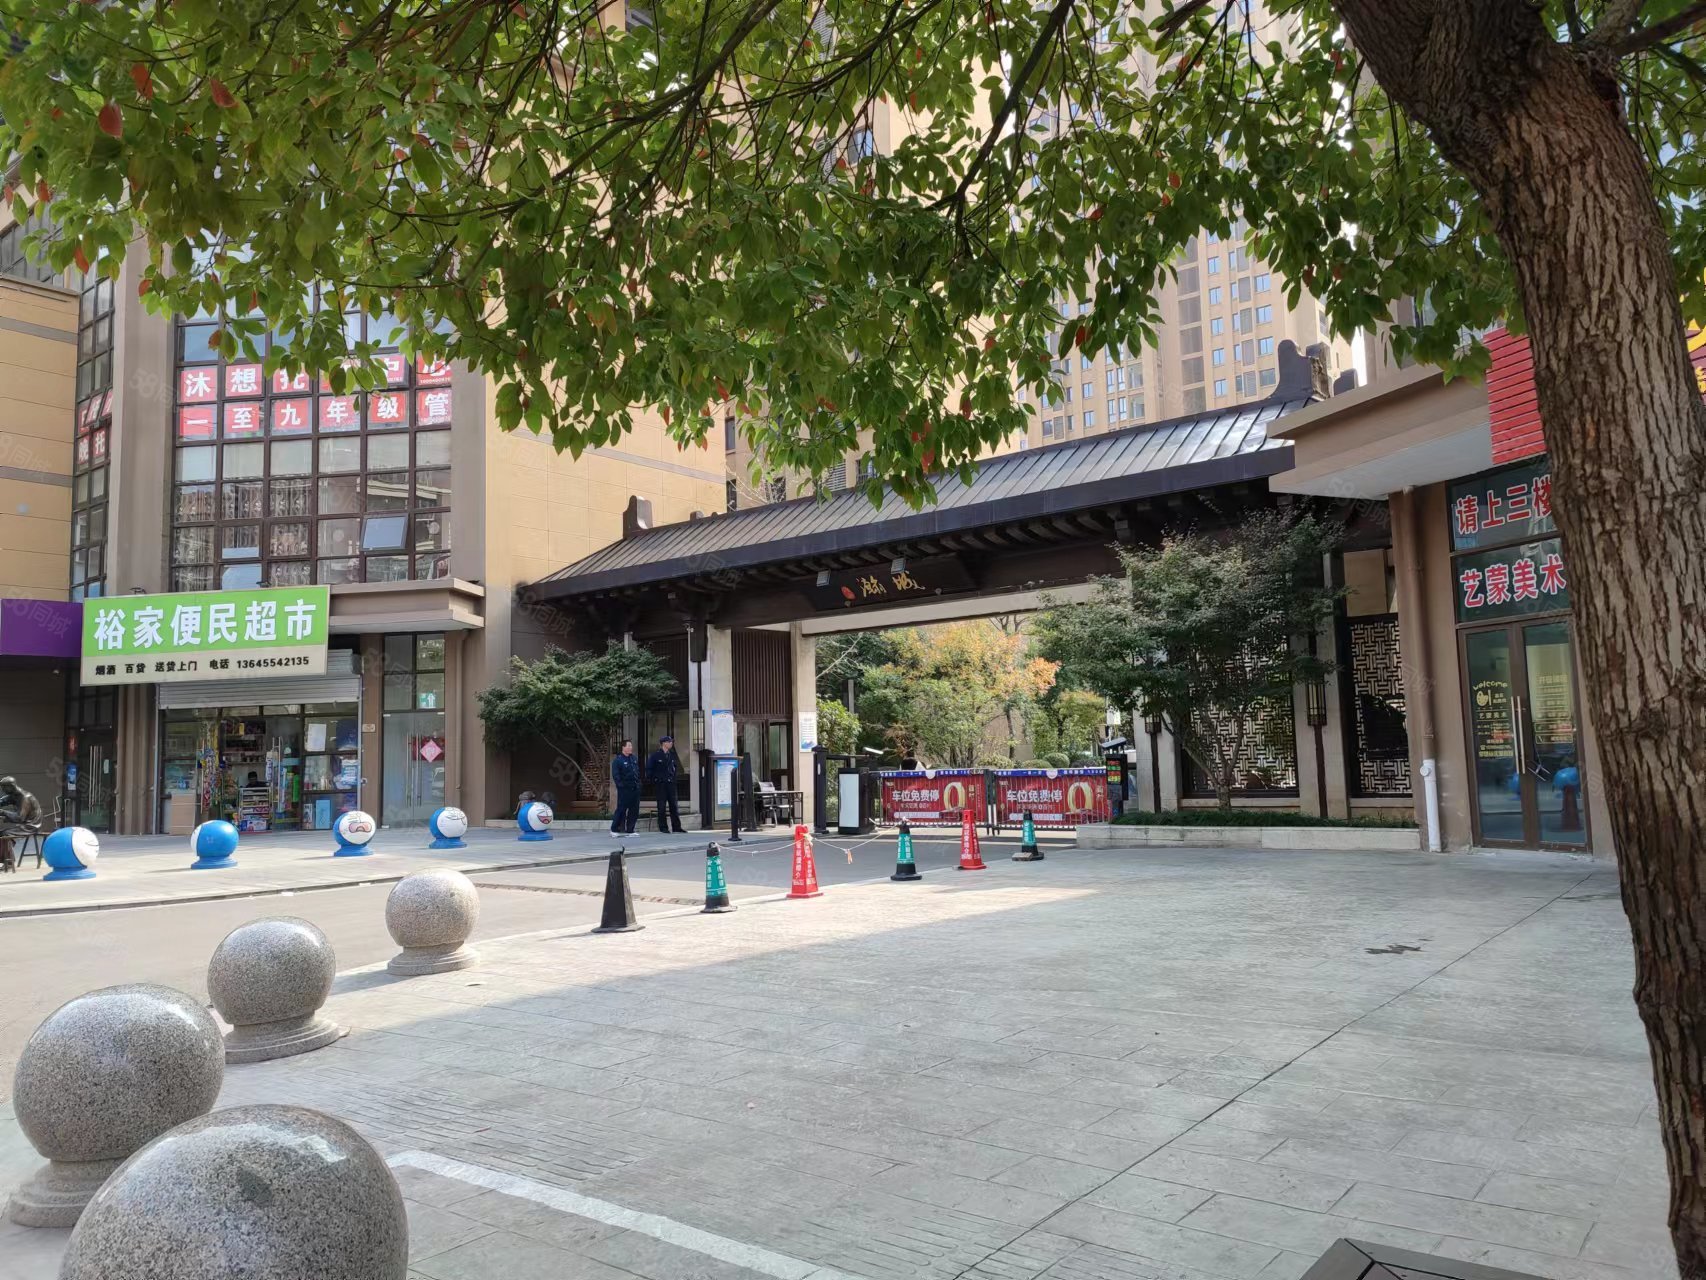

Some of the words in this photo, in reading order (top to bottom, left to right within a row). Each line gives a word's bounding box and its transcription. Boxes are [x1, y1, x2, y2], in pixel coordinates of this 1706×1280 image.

[1456, 474, 1552, 534] 请上三楼
[1460, 554, 1566, 608] 艺蒙美术
[94, 599, 316, 650] 裕家便民超市
[95, 664, 116, 676] 烟酒
[125, 663, 146, 674] 百货
[155, 660, 198, 672] 送货上门
[209, 658, 229, 670] 电话
[237, 656, 310, 669] 13645542135
[1472, 681, 1508, 691] welcome
[892, 789, 939, 802] 车位免费停
[1006, 789, 1063, 803] 车位免费停
